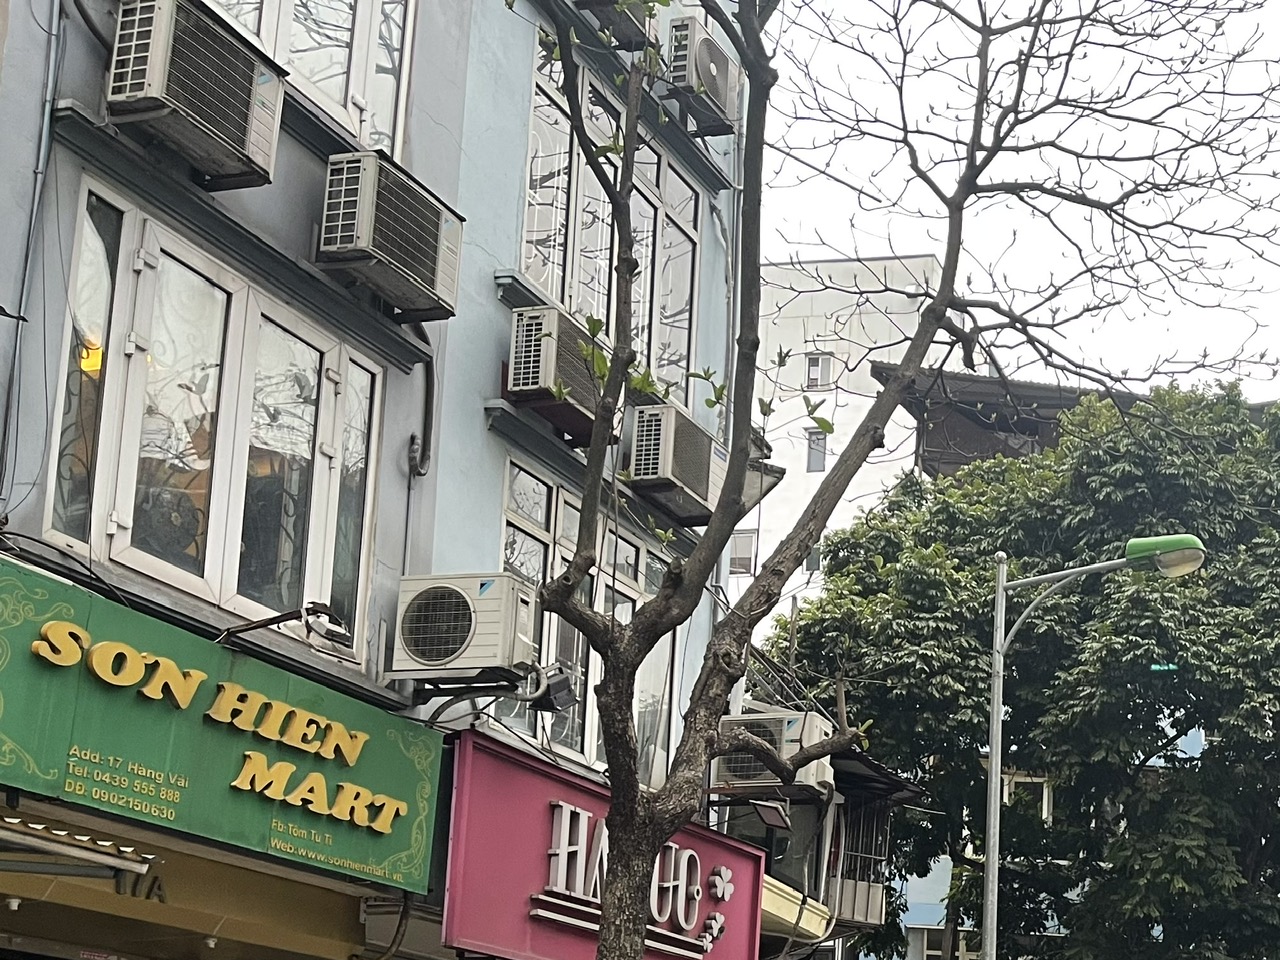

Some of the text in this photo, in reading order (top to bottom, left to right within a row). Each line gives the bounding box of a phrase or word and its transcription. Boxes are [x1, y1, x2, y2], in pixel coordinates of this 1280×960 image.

[204, 681, 370, 767] HIEN
[67, 761, 181, 803] Tel: 0439 555 888
[68, 744, 104, 764] Add:
[107, 756, 123, 769] 17
[127, 761, 164, 784] Hàng
[91, 787, 176, 821] 0902150630
[230, 750, 408, 834] MART
